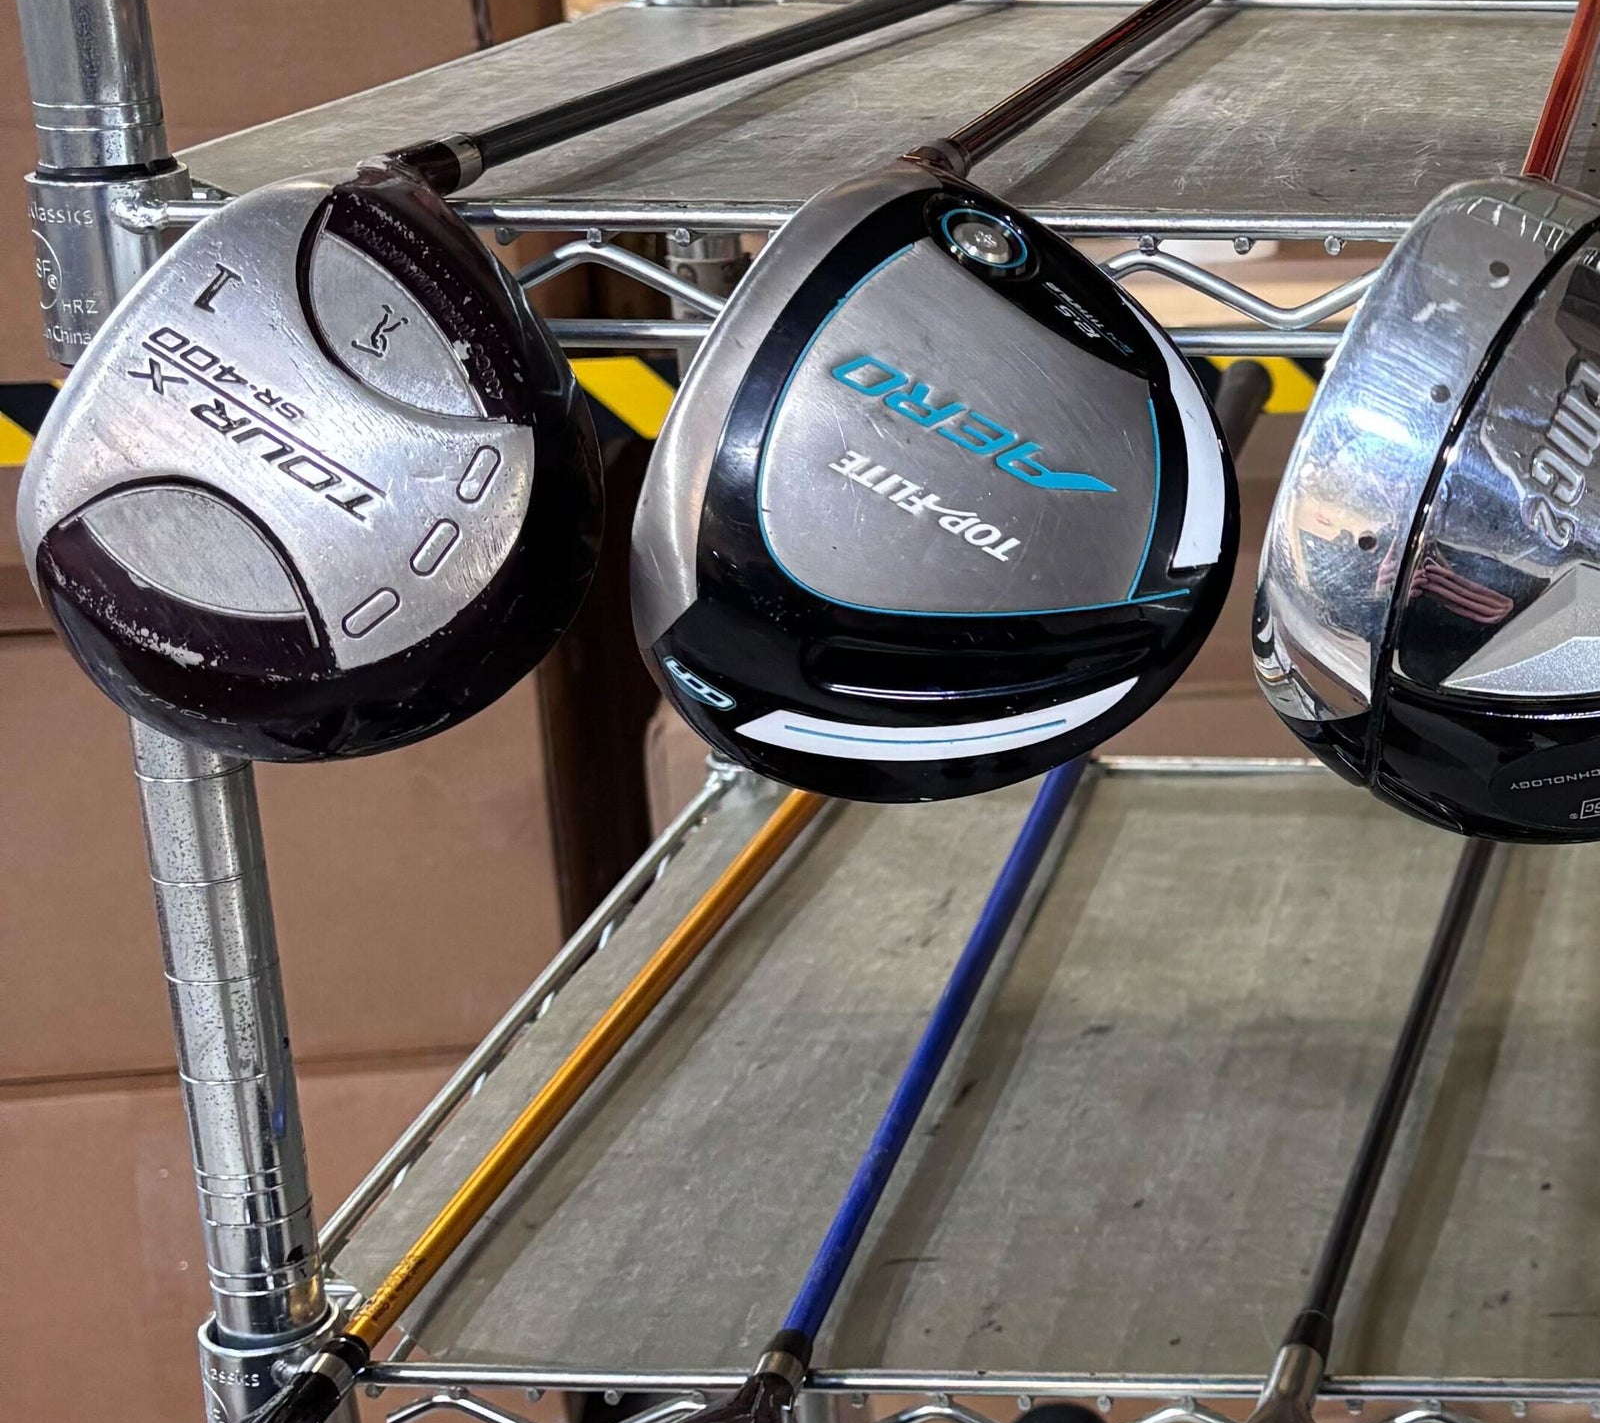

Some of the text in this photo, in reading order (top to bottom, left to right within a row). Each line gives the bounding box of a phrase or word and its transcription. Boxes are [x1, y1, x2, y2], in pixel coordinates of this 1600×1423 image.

[61, 299, 99, 315] HRZ
[196, 262, 245, 315] 1
[126, 356, 390, 523] TOUR X
[830, 355, 1118, 494] AERO
